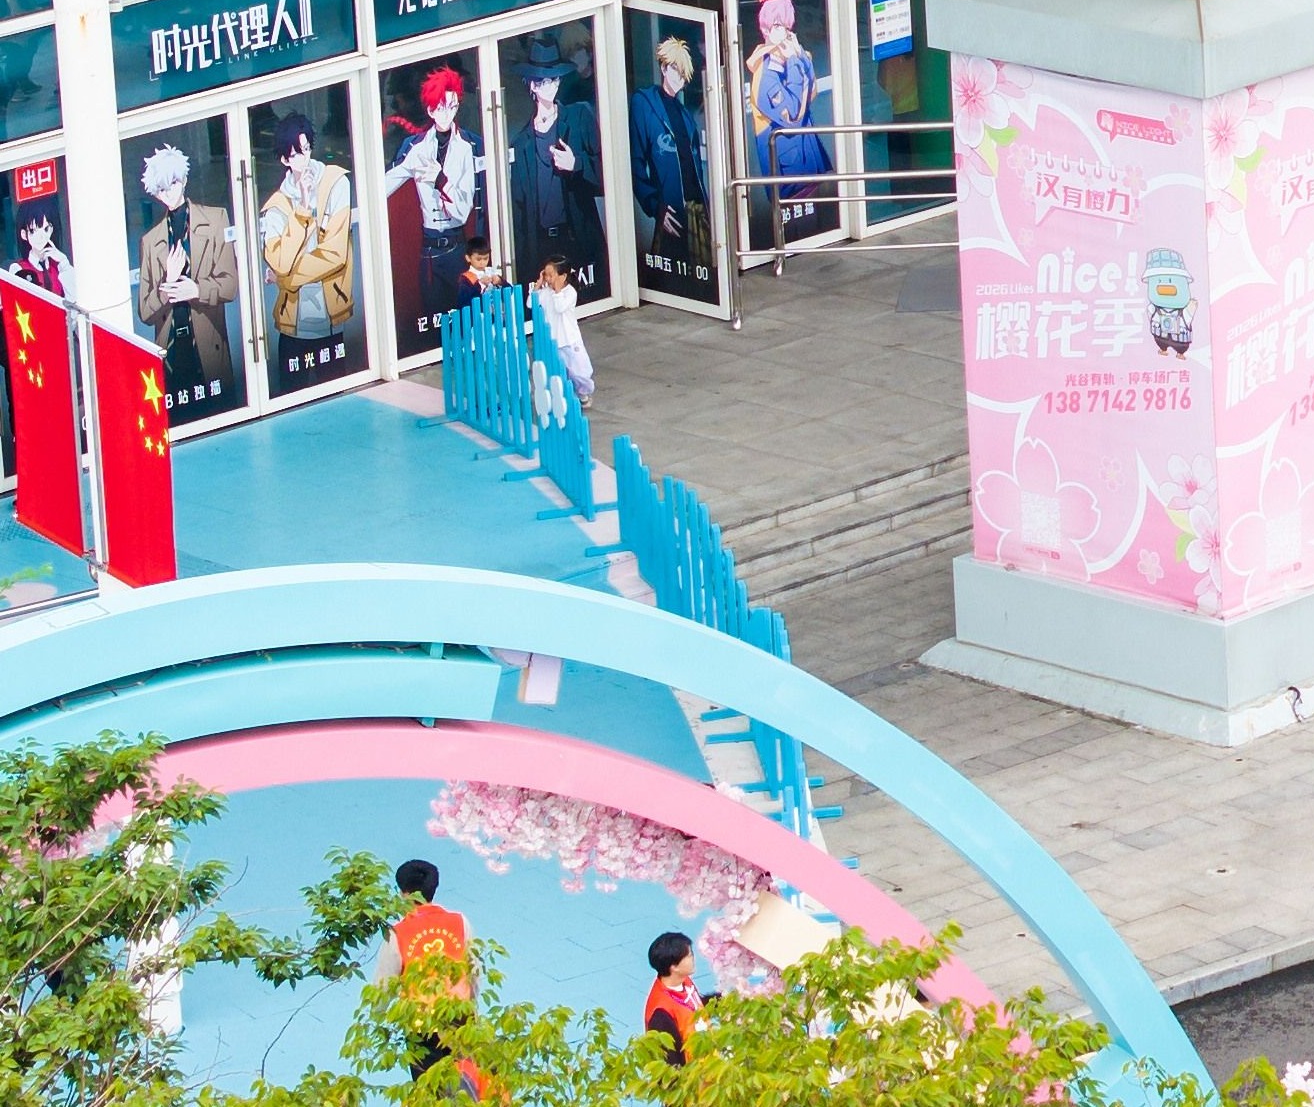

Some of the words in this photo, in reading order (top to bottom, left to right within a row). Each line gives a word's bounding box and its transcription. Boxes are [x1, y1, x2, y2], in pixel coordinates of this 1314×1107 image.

[228, 50, 258, 64] LINK
[269, 38, 307, 53] CLICK
[22, 165, 51, 189] 出口
[1035, 172, 1131, 217] 汉有樱力
[781, 202, 814, 224] 站独播
[645, 253, 672, 273] 每周五
[976, 283, 1008, 295] 2026
[1009, 284, 1034, 295] Likes
[975, 298, 1147, 361] 樱花季
[165, 379, 221, 410] B站独播
[1044, 391, 1081, 414] 138
[1087, 390, 1137, 413] 7142
[1143, 387, 1192, 412] 9816
